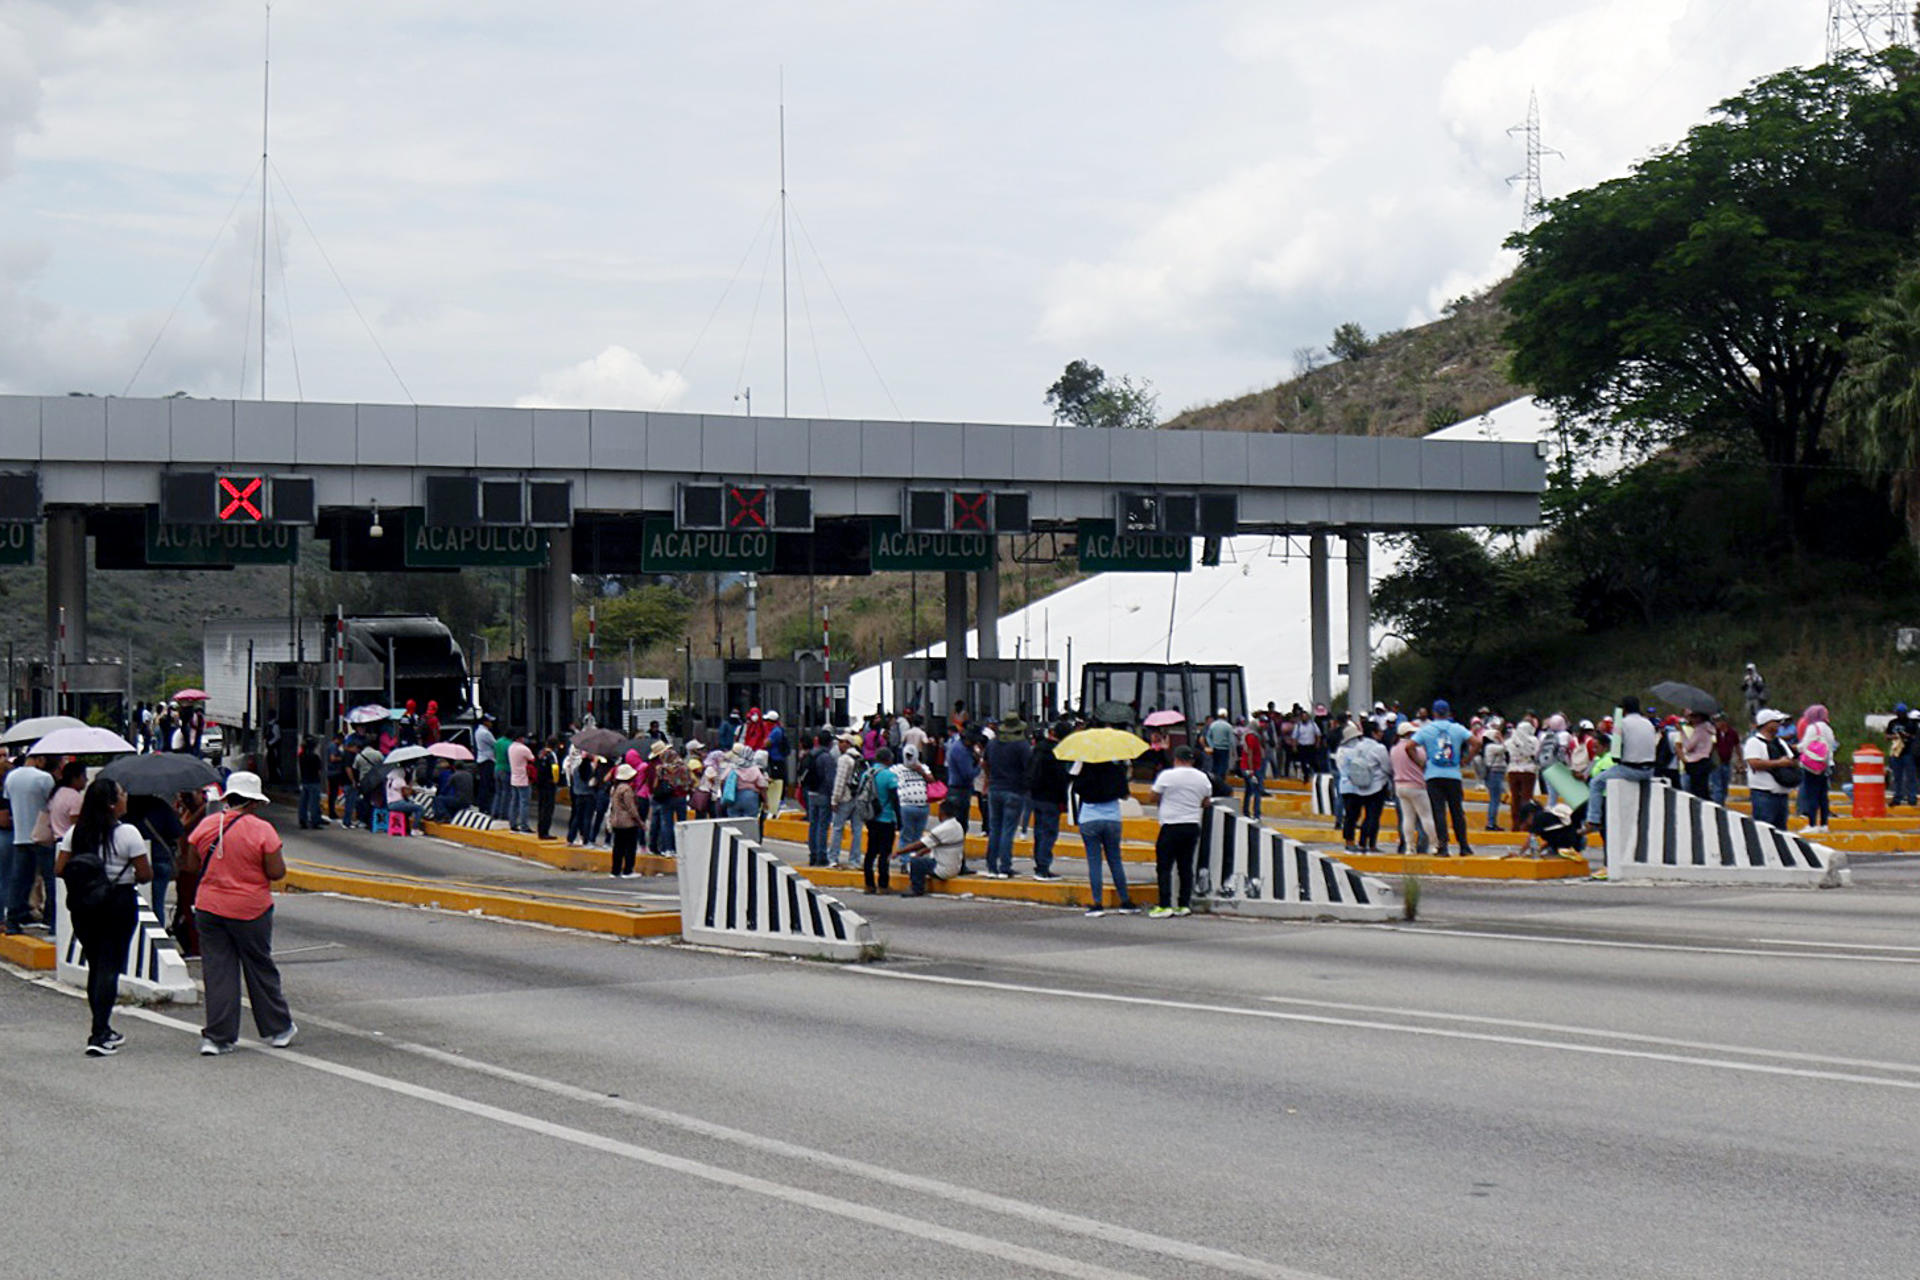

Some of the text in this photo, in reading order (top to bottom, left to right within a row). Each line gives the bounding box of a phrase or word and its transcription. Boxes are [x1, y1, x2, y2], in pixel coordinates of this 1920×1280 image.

[155, 525, 289, 548] ACAPULCO
[415, 525, 538, 551] ACAPULCO
[650, 533, 767, 557] ACAPULCO
[878, 532, 986, 556] ACAPULCO
[1085, 535, 1186, 559] ACAPULCO
